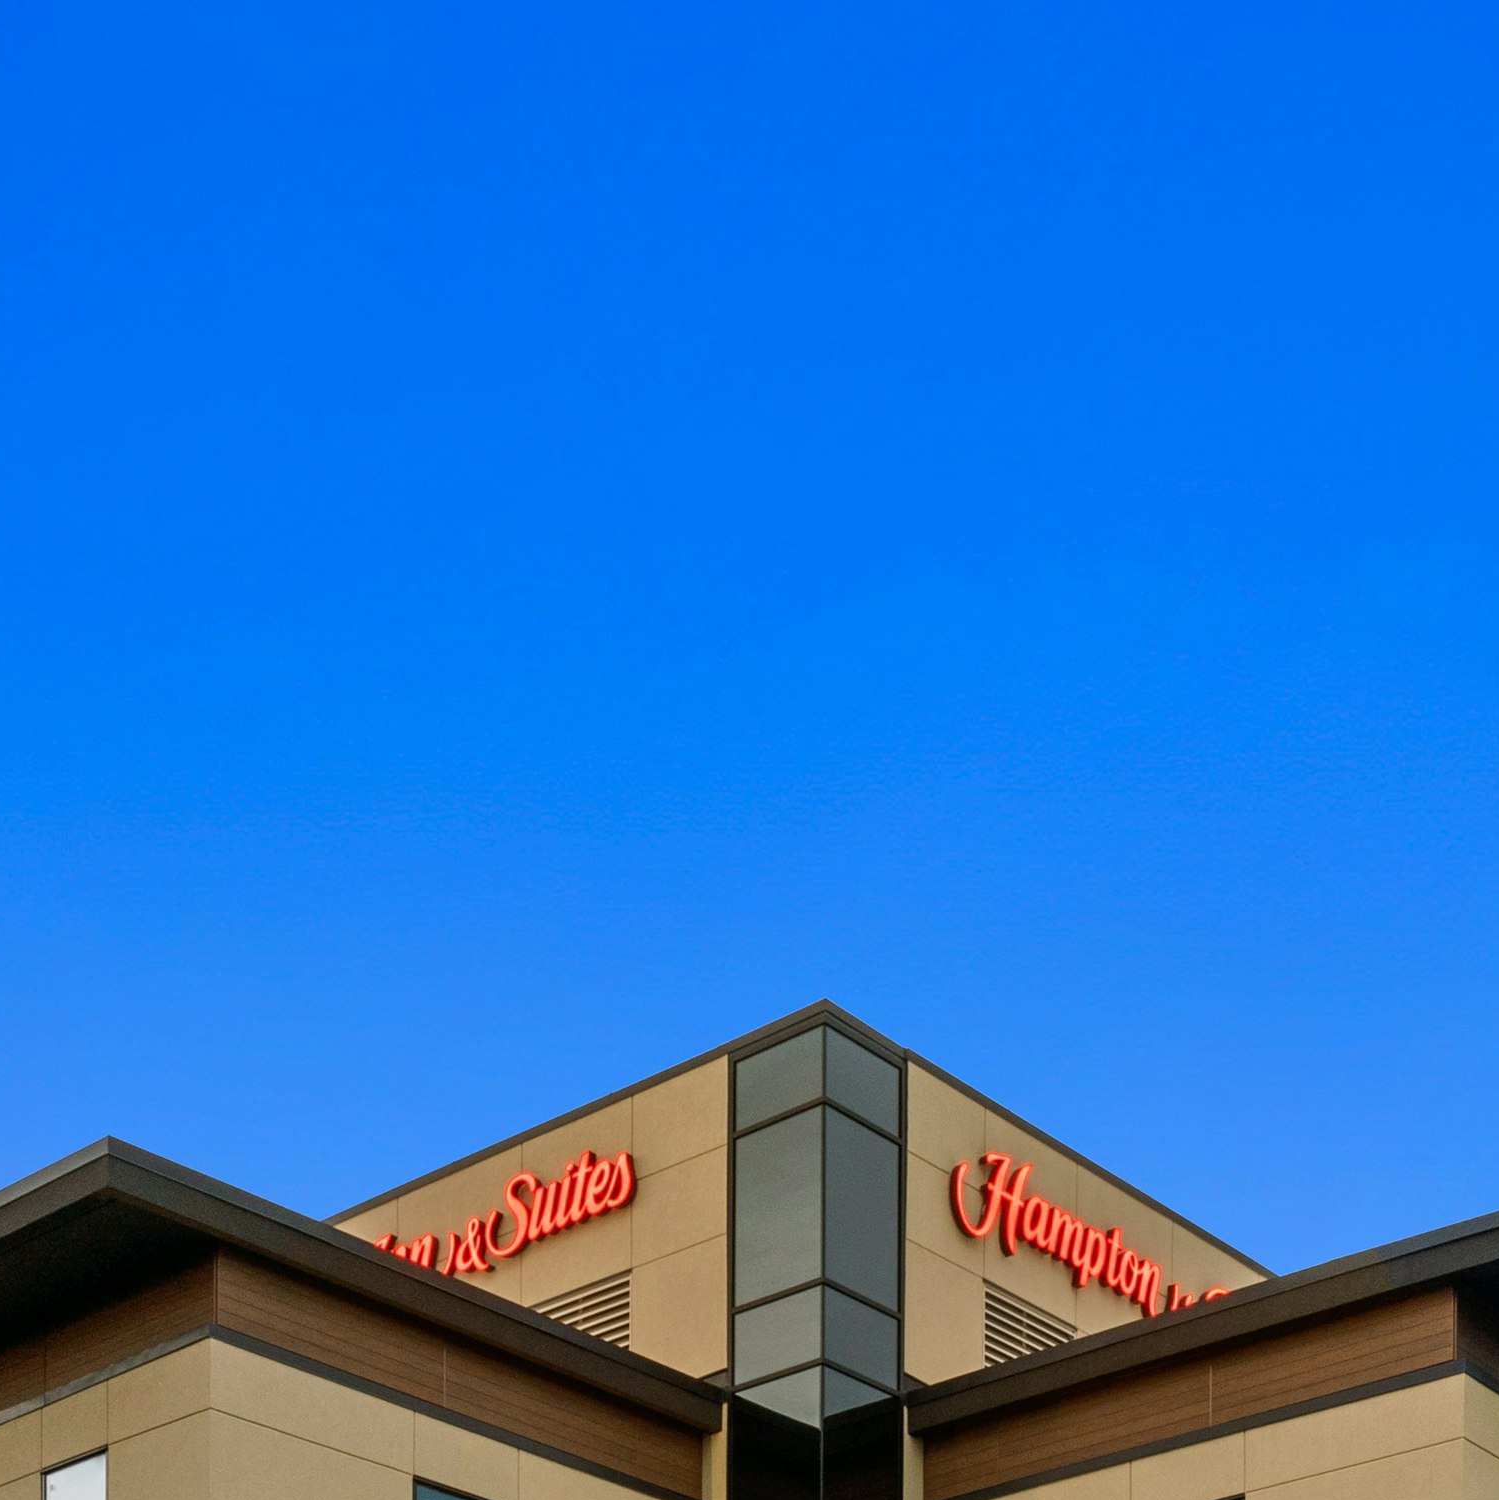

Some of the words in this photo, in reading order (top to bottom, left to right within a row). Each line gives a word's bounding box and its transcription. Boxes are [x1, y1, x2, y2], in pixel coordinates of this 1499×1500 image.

[455, 1215, 490, 1272] &
[485, 1149, 635, 1257] Suites
[951, 1151, 1181, 1318] Hampton
